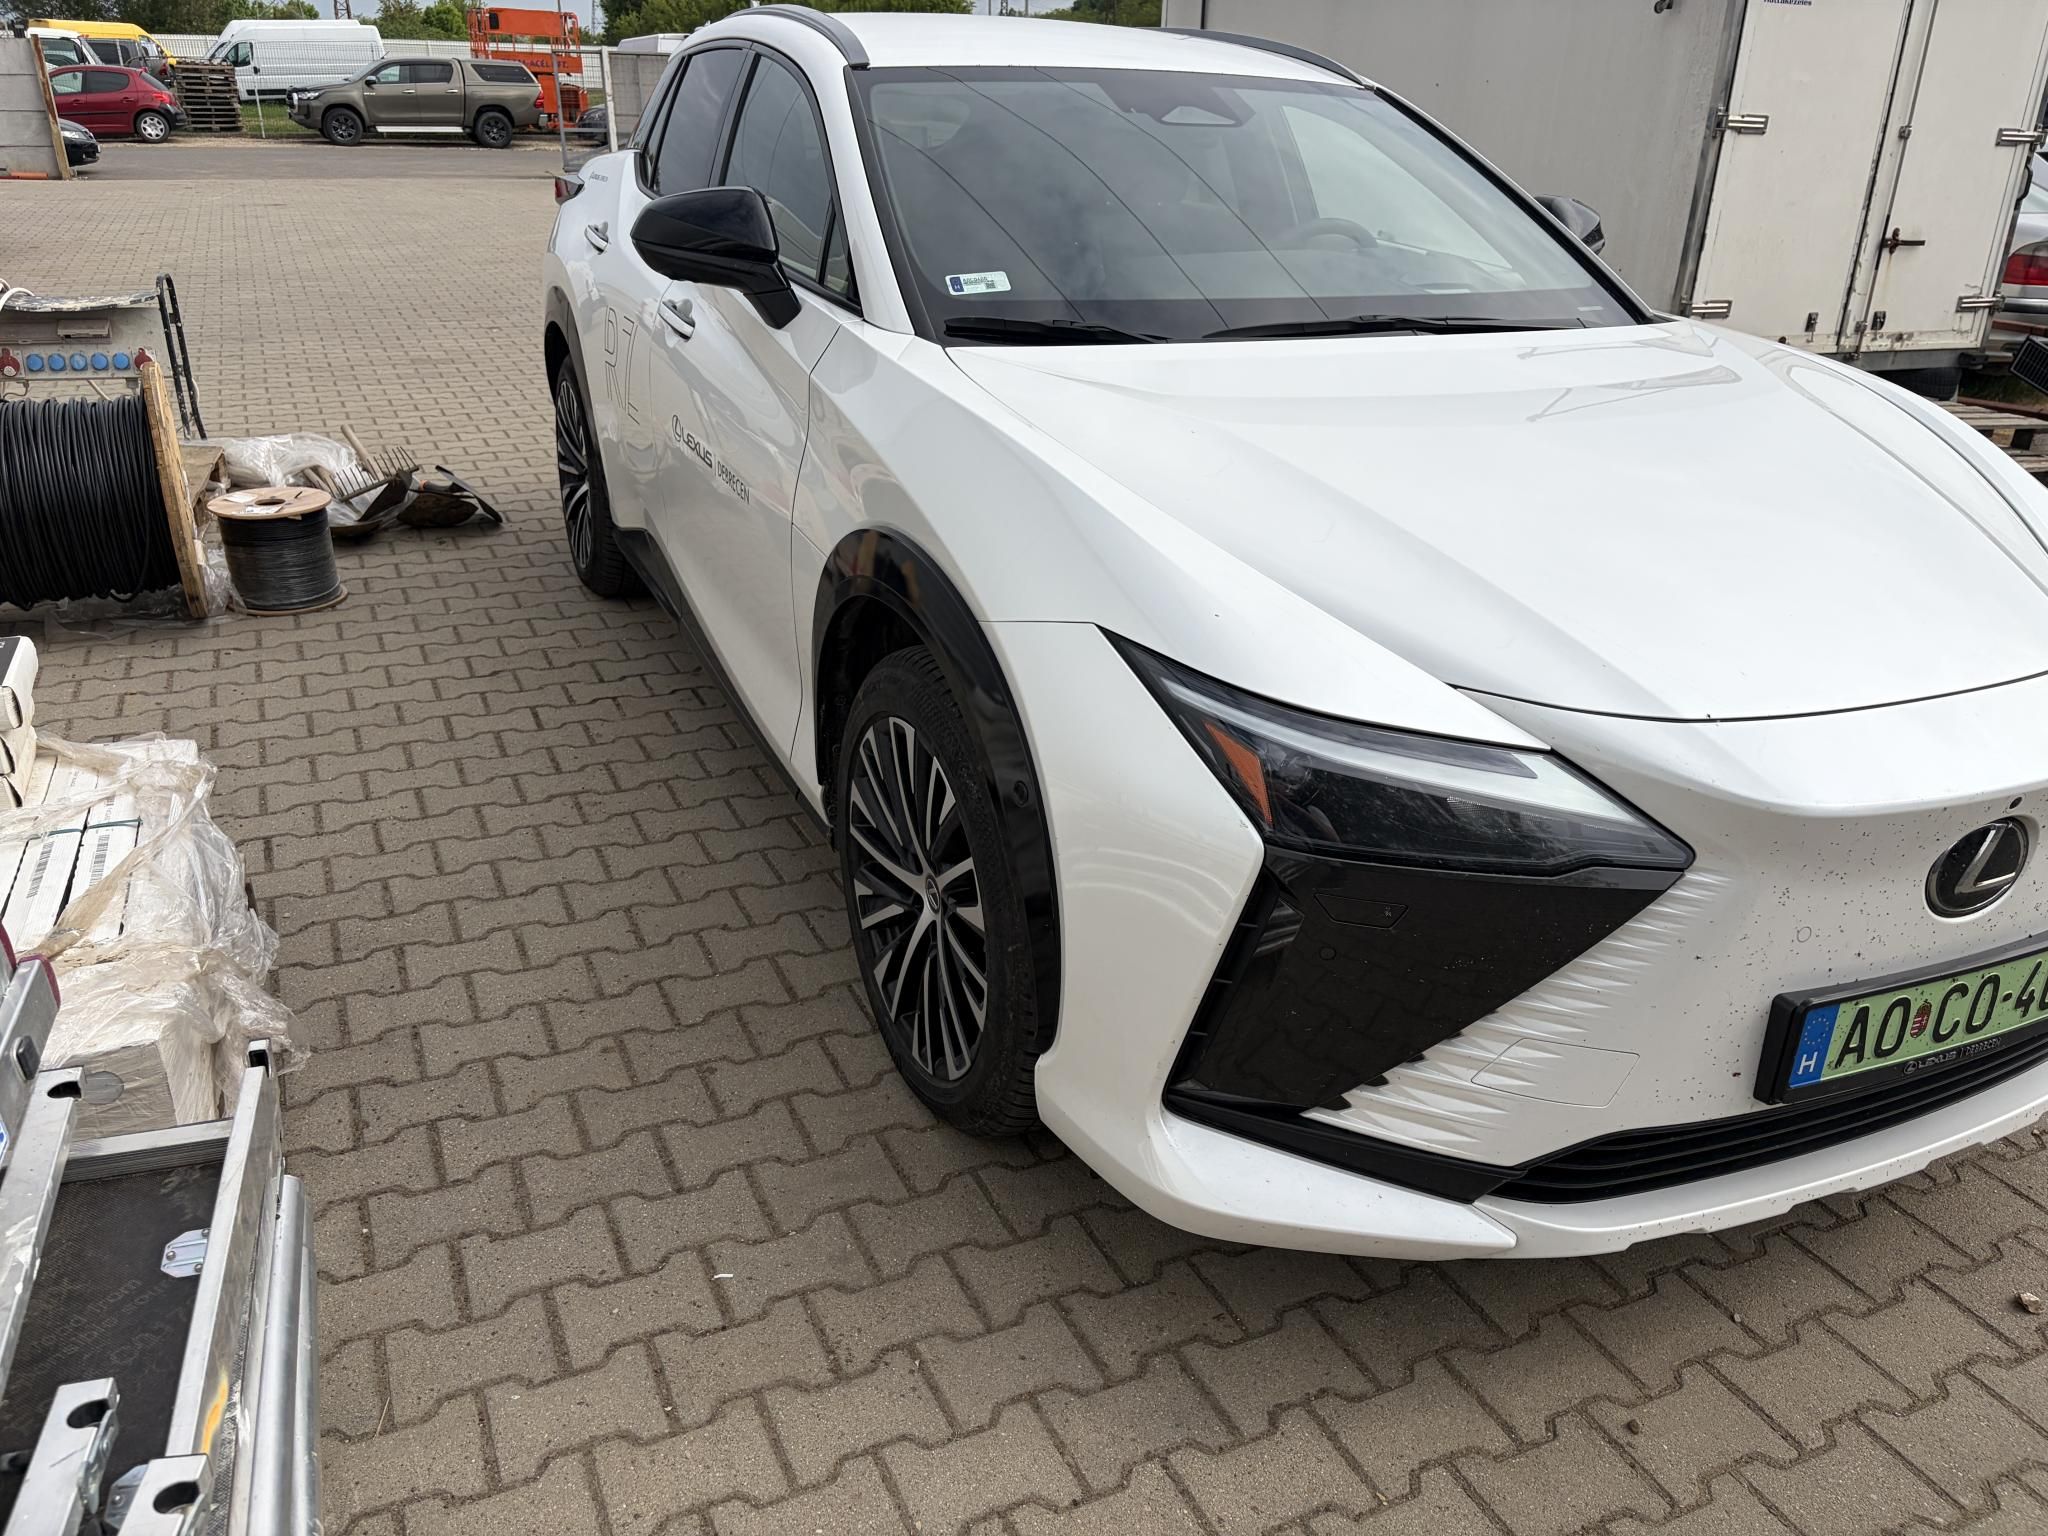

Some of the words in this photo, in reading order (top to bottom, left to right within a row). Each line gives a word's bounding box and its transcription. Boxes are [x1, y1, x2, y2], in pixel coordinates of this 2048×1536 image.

[681, 426, 713, 469] LEXUS
[717, 460, 751, 505] DEBRECEN
[1797, 1051, 1819, 1075] H
[1918, 1051, 1957, 1068] LEXUS
